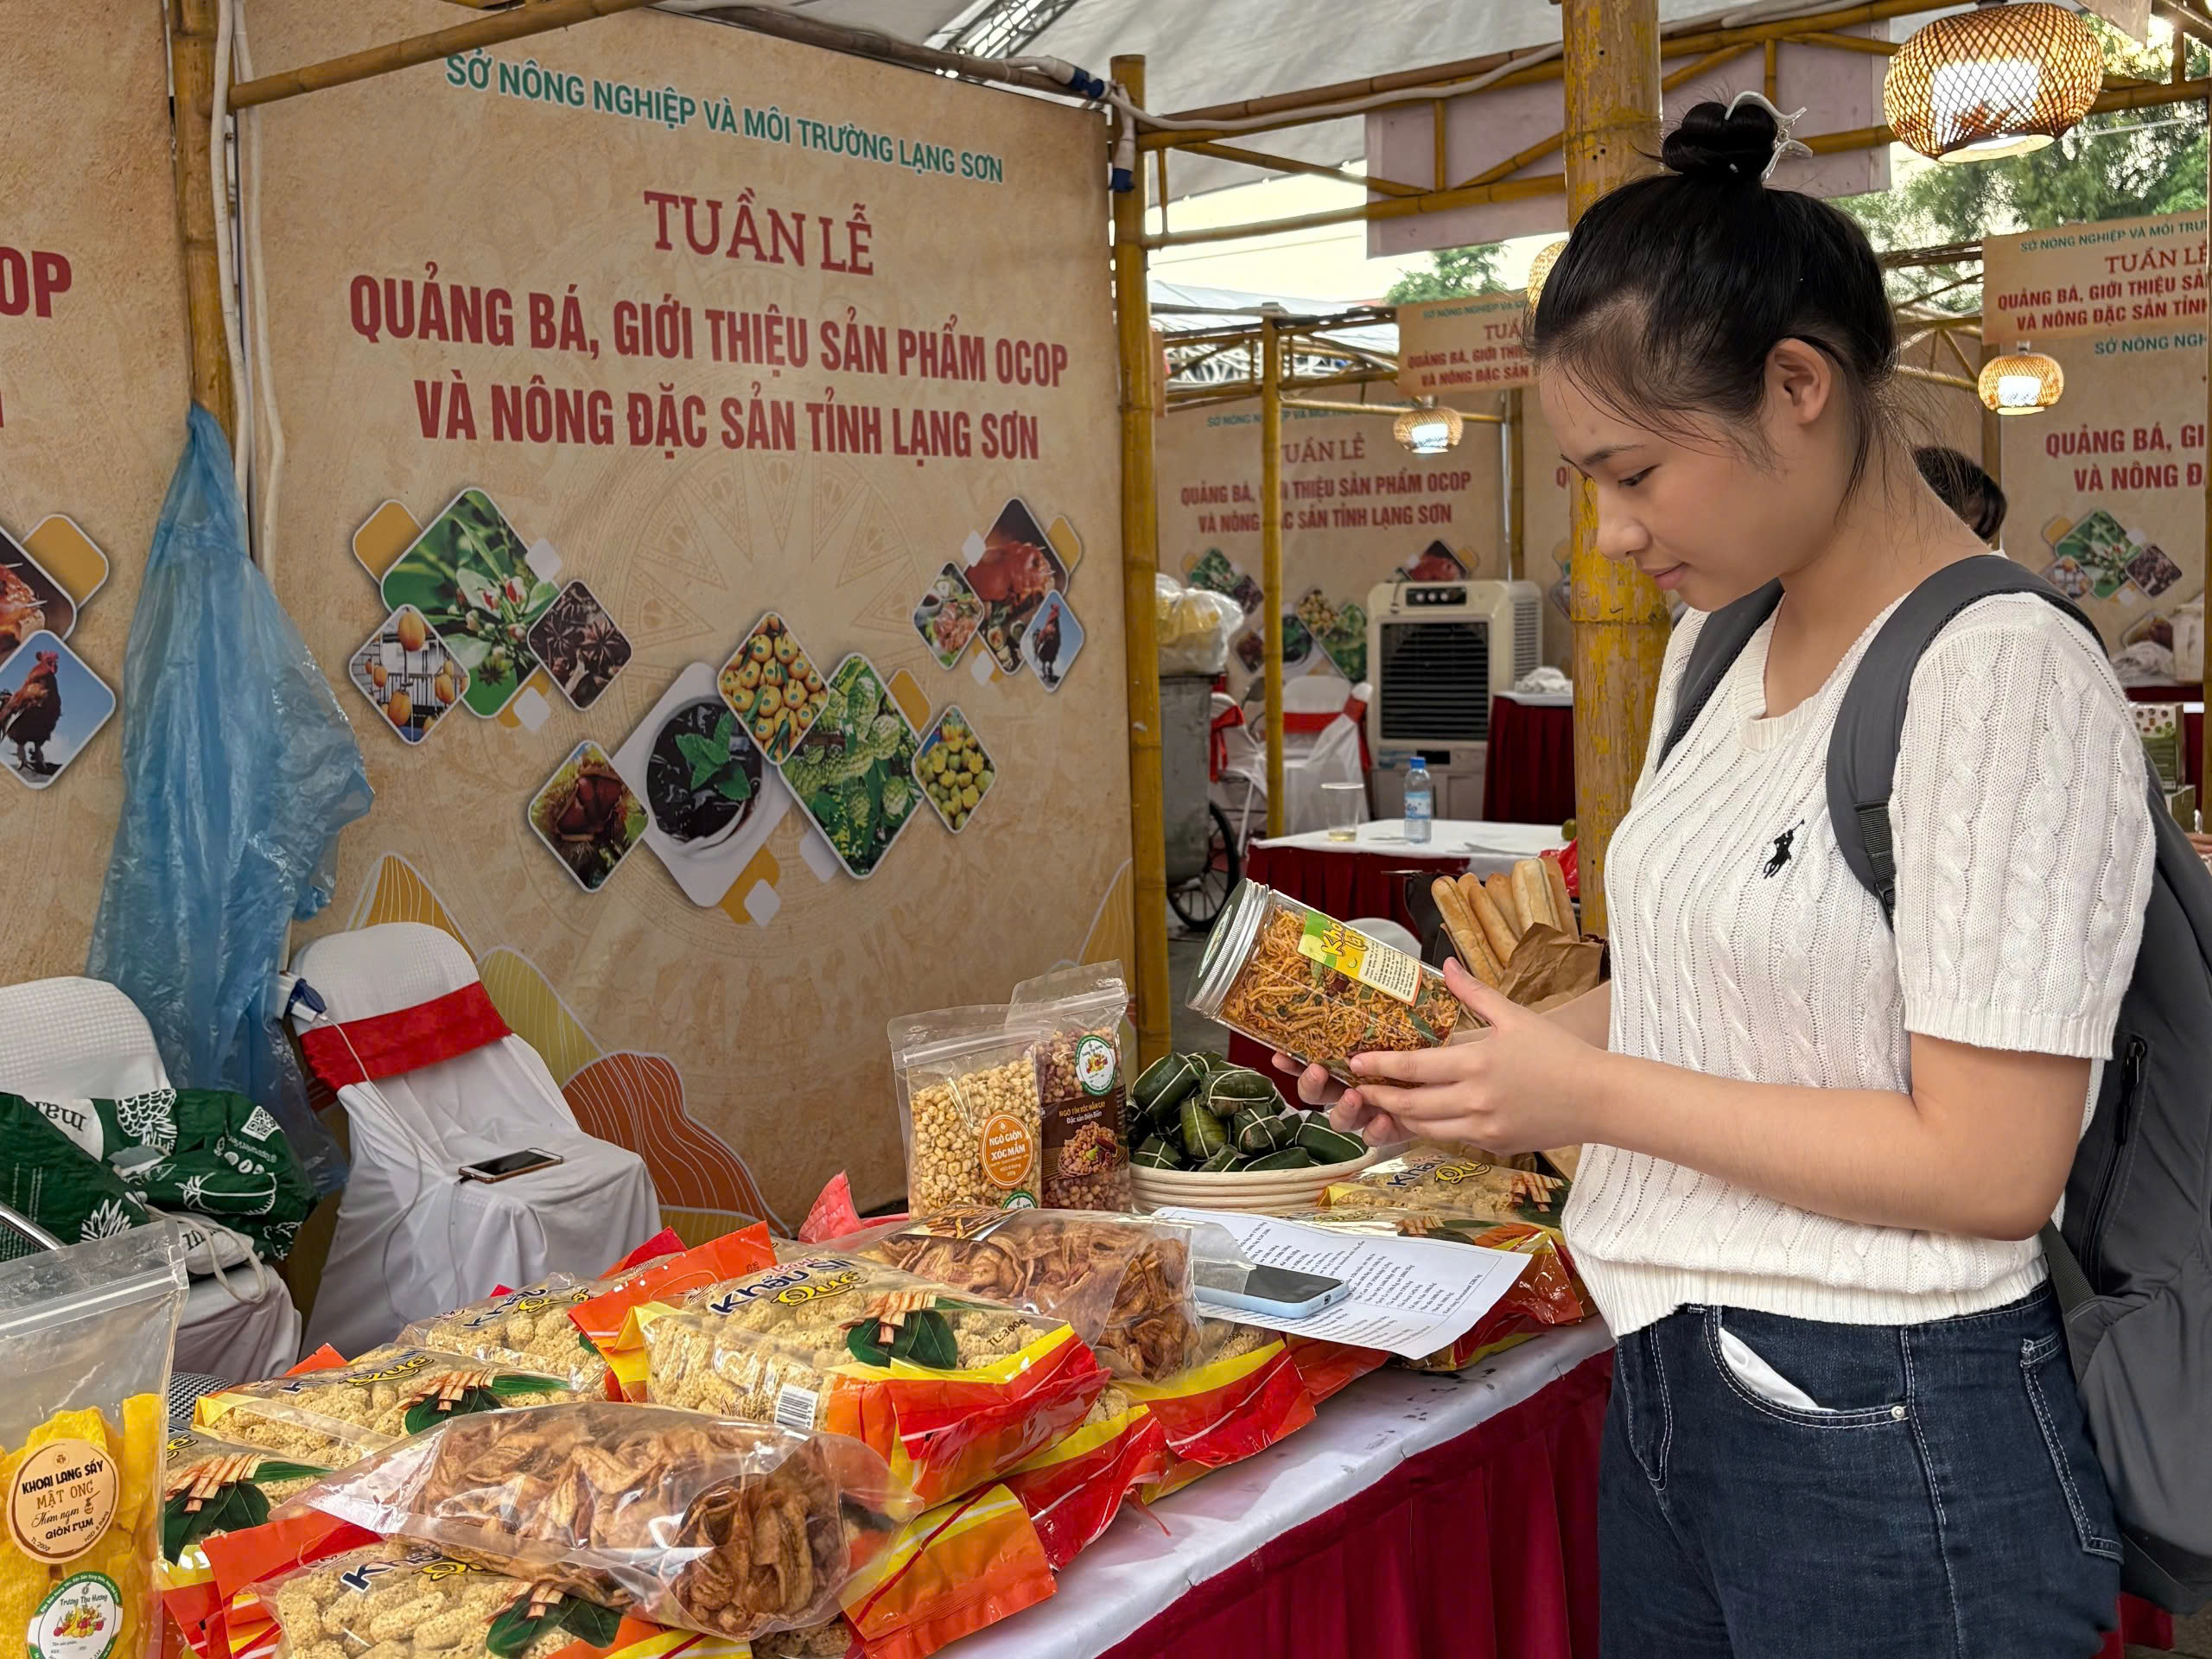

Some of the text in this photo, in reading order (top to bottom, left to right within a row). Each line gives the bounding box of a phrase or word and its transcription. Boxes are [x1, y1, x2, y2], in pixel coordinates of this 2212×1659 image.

[446, 48, 1003, 184] SỞ NÔNG NGHIỆP VÀ MÔI TRƯỜNG LẠNG SƠN
[644, 187, 874, 276] TUẦN LỄ
[2020, 239, 2037, 253] SỞ
[2040, 236, 2075, 250] NÔNG
[2079, 228, 2126, 246] NGHIỆP
[2129, 223, 2146, 239] VÀ
[2149, 221, 2174, 237] MÔI
[2105, 246, 2177, 275] TUẦN
[1998, 288, 2051, 311] QUẢNG
[2057, 284, 2083, 303] BÁ,
[2089, 282, 2122, 301] GIỚI
[2127, 276, 2176, 297] THIỆU
[350, 261, 1068, 388] QUẢNG BÁ, GIỚI THIỆU SẢN PHẨM OCOP
[2017, 314, 2037, 332] VÀ
[2043, 309, 2088, 329] NÔNG
[2093, 307, 2126, 327] ĐẶC
[2133, 300, 2167, 321] SẢN
[1407, 349, 1446, 370] QUẢNG
[2094, 333, 2207, 355] SỞ NÔNG NGH
[1439, 369, 1472, 386] NÔNG
[413, 368, 1039, 467] VÀ NÔNG ĐẶC SẢN TỈNH LẠNG SƠN
[1281, 436, 1335, 464] UẦN
[2046, 422, 2204, 459] QUẢNG BÁ, GI
[1180, 479, 1228, 507] QUẢNG
[1293, 475, 1335, 504] THIỆU
[1339, 469, 1371, 498] SẢN
[1375, 467, 1422, 496] PHẨM
[1427, 470, 1472, 493] OCOP
[2074, 463, 2104, 493] VÀ
[2112, 460, 2178, 491] NÔNG
[1198, 511, 1217, 534] VÀ
[1219, 511, 1261, 533] NÔNG
[1298, 503, 1329, 530] SẢN
[1332, 501, 1368, 529] TỈNH
[1372, 504, 1414, 531] LẠNG
[1418, 502, 1452, 525] SƠN
[991, 1147, 1007, 1161] XÓC
[1007, 1141, 1027, 1157] MẮM
[1005, 1129, 1023, 1142] GIÒN
[1434, 1160, 1491, 1185] Qu
[709, 1269, 810, 1315] Khẩu
[770, 1271, 868, 1306] Quế
[22, 1458, 104, 1495] KHOAI LANG SẤY
[36, 1479, 94, 1510] MẬT ONG
